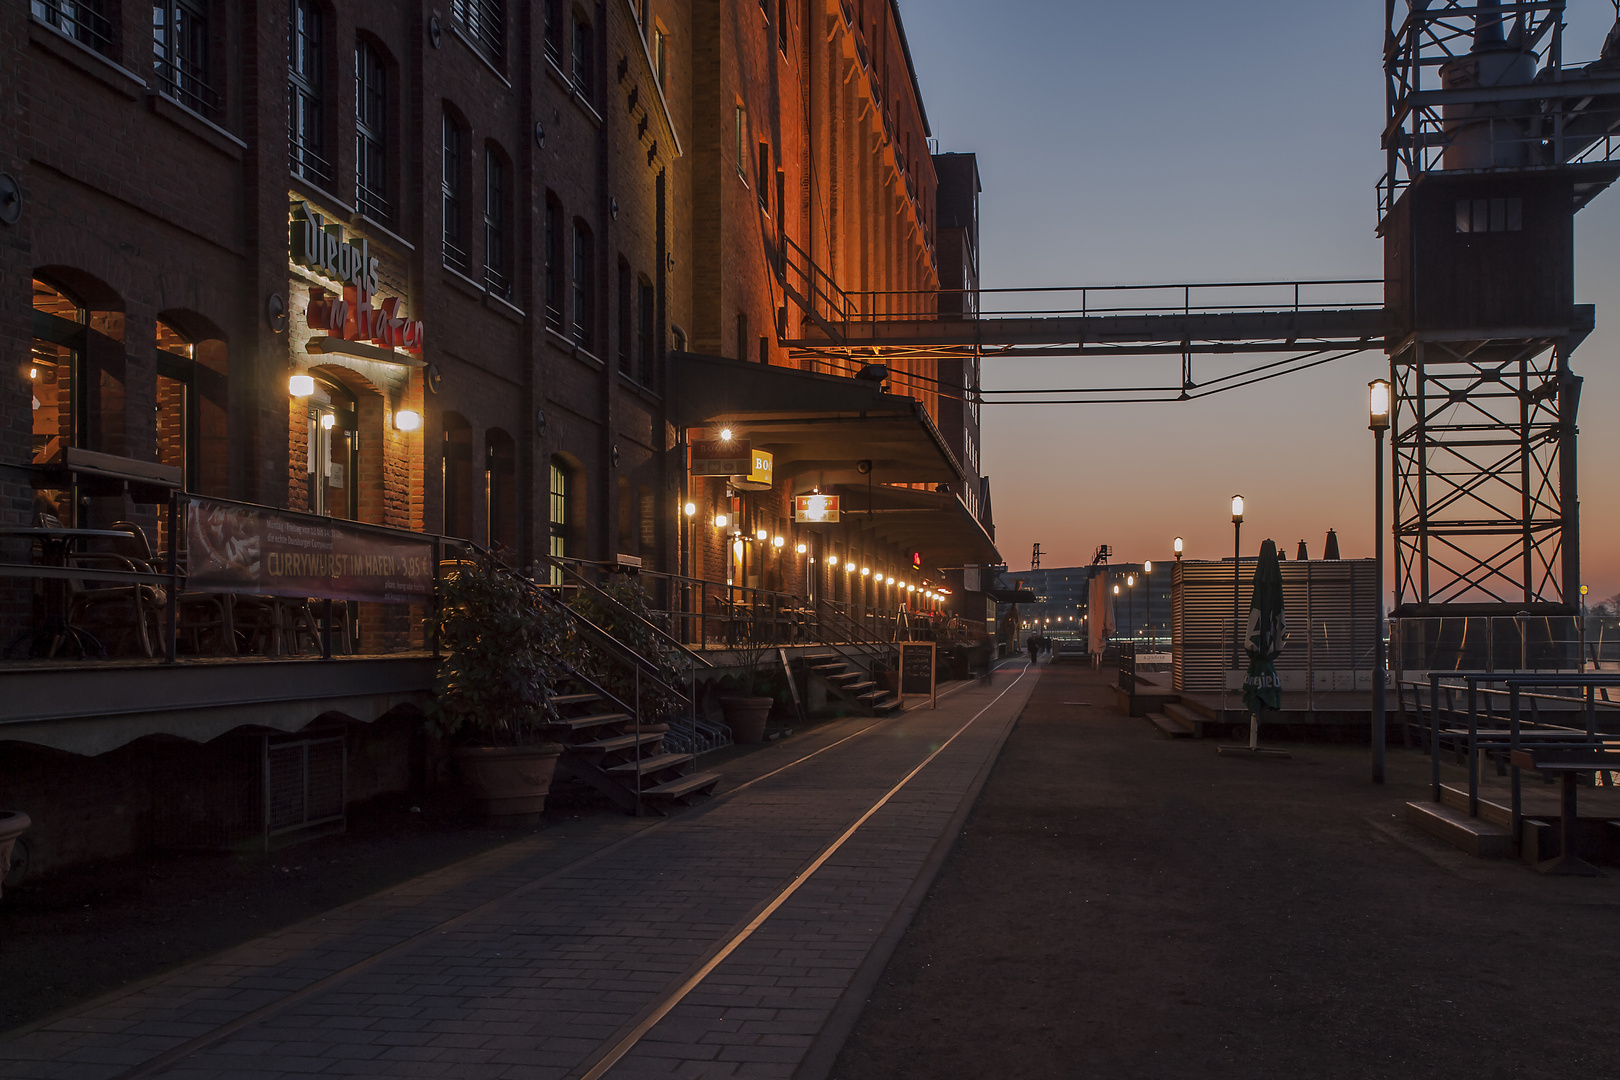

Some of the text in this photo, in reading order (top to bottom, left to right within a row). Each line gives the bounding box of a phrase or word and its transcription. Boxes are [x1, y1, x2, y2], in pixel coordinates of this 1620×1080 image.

[357, 275, 424, 359] Hafen
[267, 552, 348, 577] CURRYWURST
[350, 554, 363, 576] IM
[365, 554, 395, 576] HAFEN
[401, 556, 421, 579] 3,95
